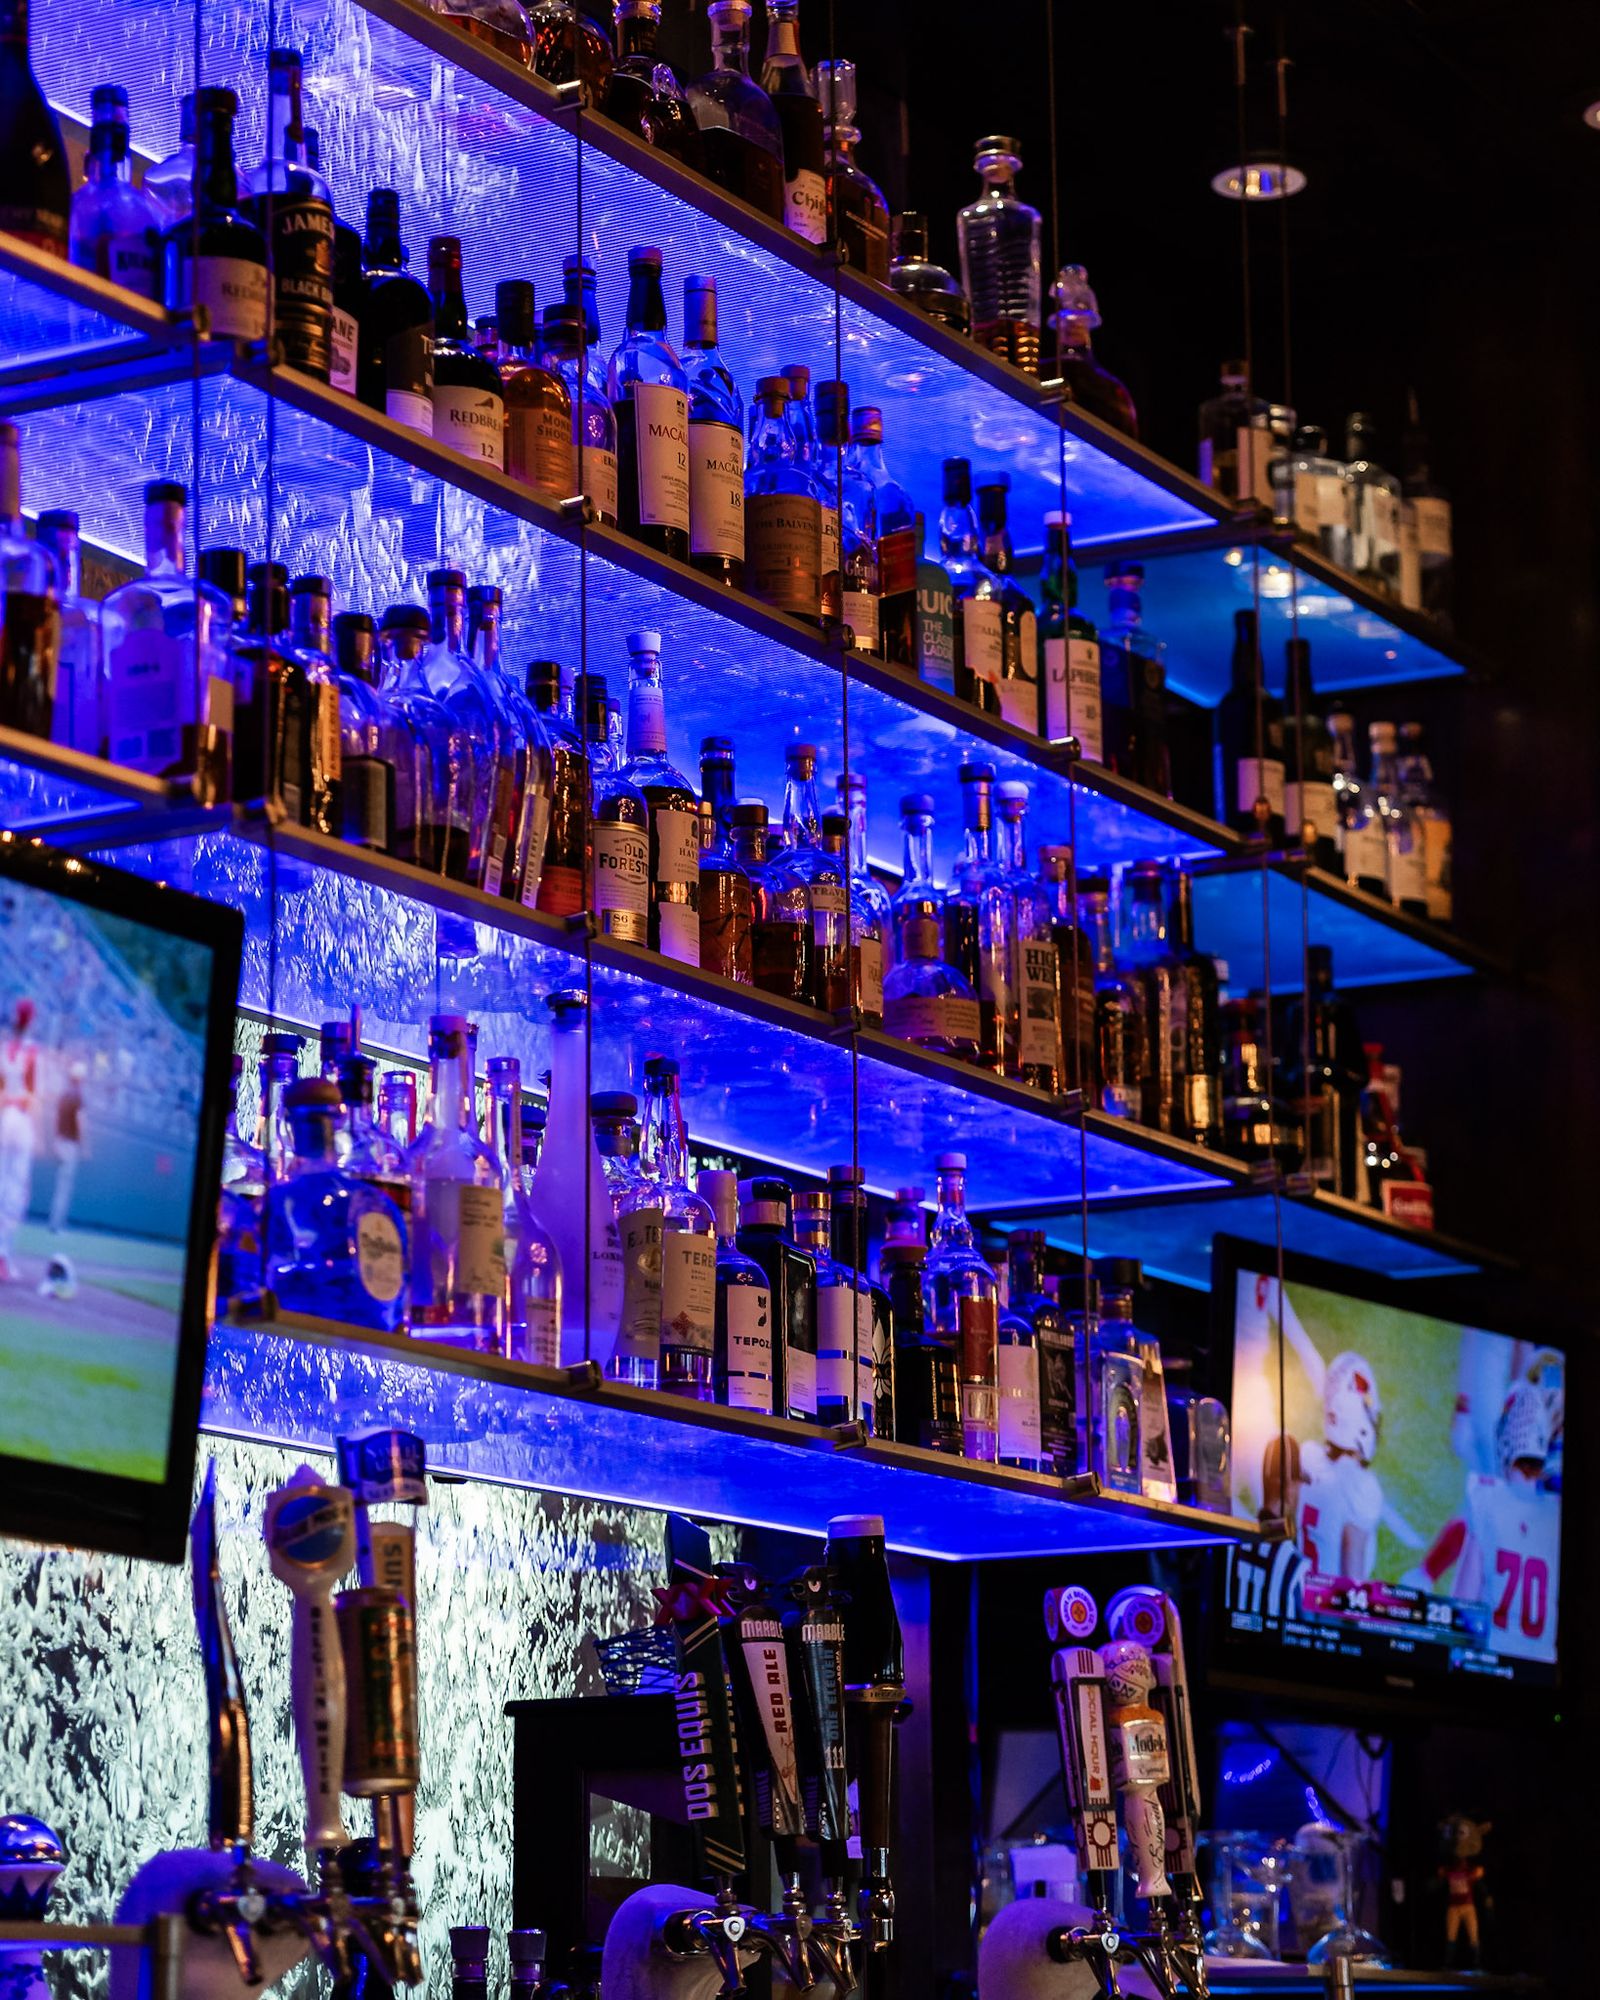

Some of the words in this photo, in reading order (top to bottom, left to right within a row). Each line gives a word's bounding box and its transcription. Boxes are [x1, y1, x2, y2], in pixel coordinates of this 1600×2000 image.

[480, 442, 494, 459] 12
[676, 451, 687, 466] 12
[731, 491, 742, 507] 18
[922, 619, 944, 634] THE
[612, 913, 629, 924] 86
[1346, 1587, 1368, 1610] 14
[1493, 1549, 1547, 1638] 70
[740, 1619, 785, 1640] MARBLE
[801, 1623, 846, 1643] MARBLE
[763, 1648, 780, 1686] ALE
[674, 1672, 706, 1757] EQUIS
[769, 1691, 789, 1735] RED
[825, 1707, 840, 1741] ONE
[1089, 1734, 1101, 1775] HOUR
[682, 1763, 712, 1821] DOS
